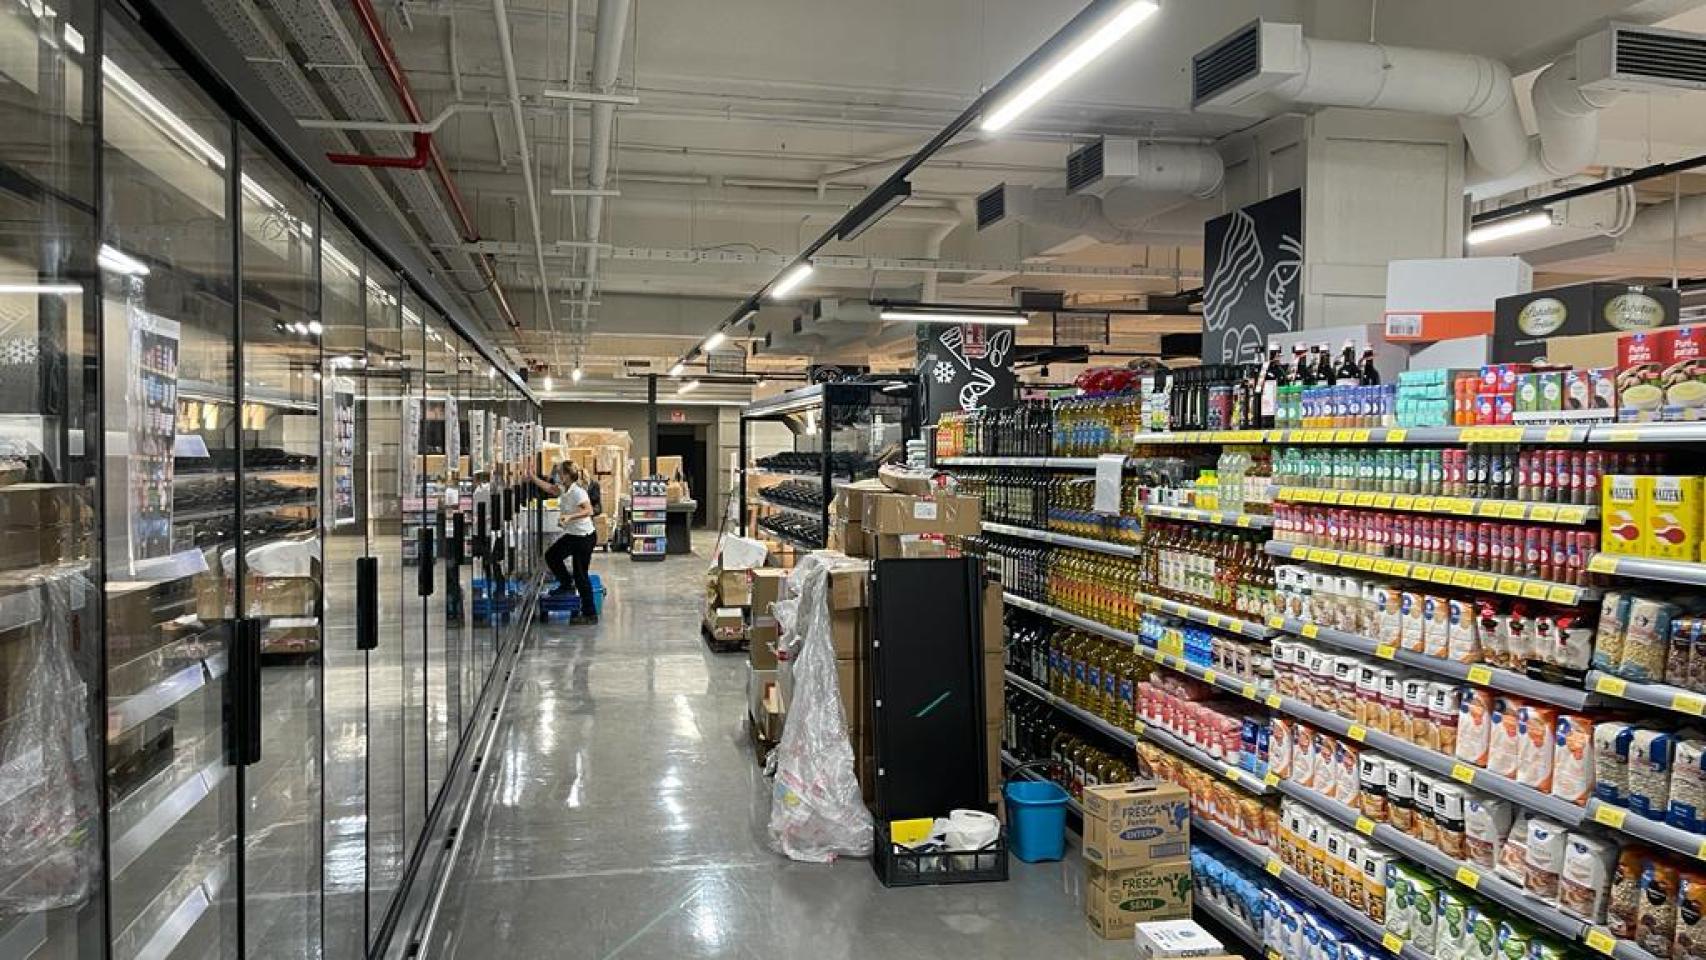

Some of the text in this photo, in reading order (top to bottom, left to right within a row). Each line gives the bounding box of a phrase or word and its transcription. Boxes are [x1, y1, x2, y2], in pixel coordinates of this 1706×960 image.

[1122, 804, 1161, 818] FRESCA
[1122, 876, 1164, 890] FRESCA
[1130, 899, 1154, 910] SEMI
